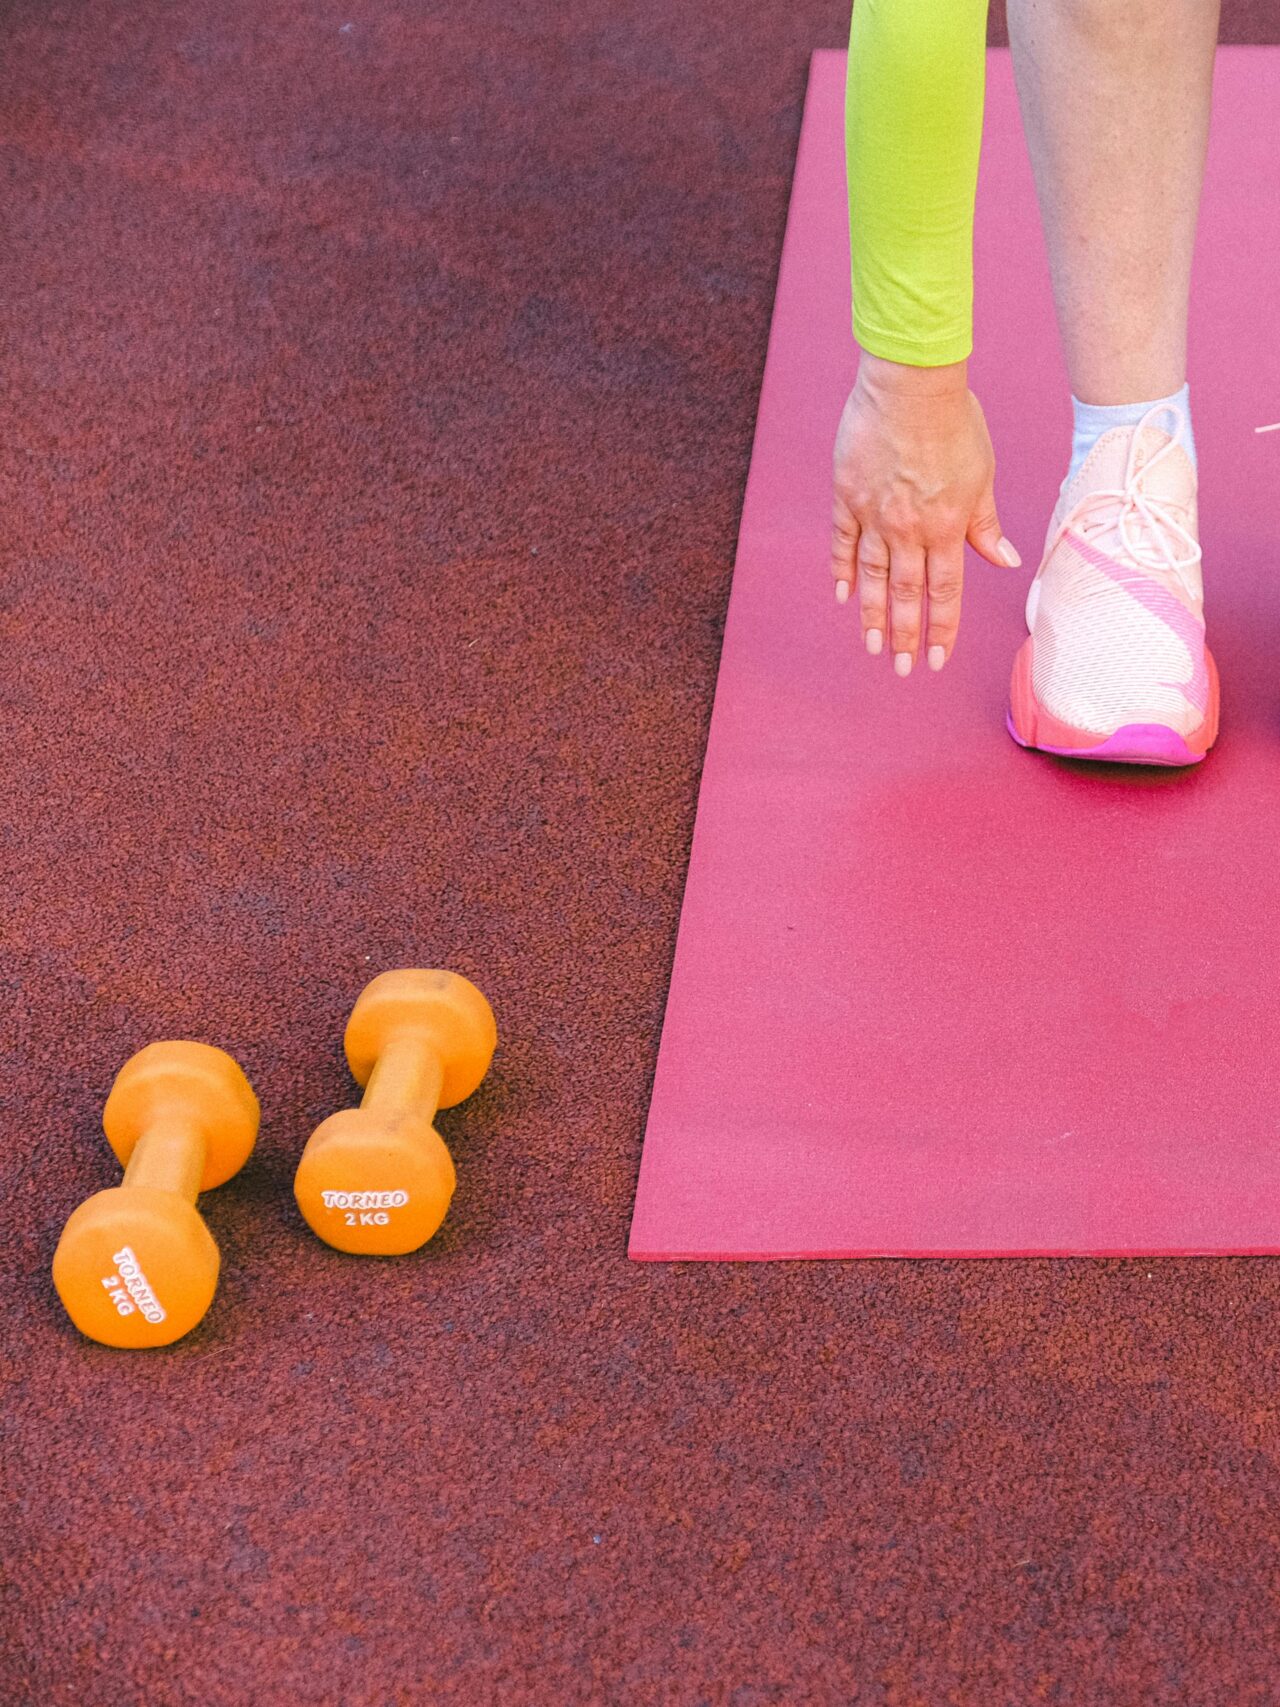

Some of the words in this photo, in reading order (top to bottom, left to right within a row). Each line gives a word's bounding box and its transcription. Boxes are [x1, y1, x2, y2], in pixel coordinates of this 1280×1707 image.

[321, 1190, 408, 1209] TORNEO
[344, 1213, 356, 1226] 2
[360, 1212, 389, 1226] KG
[101, 1275, 119, 1289] 2
[113, 1246, 166, 1323] TORNEO
[109, 1289, 135, 1316] KG
